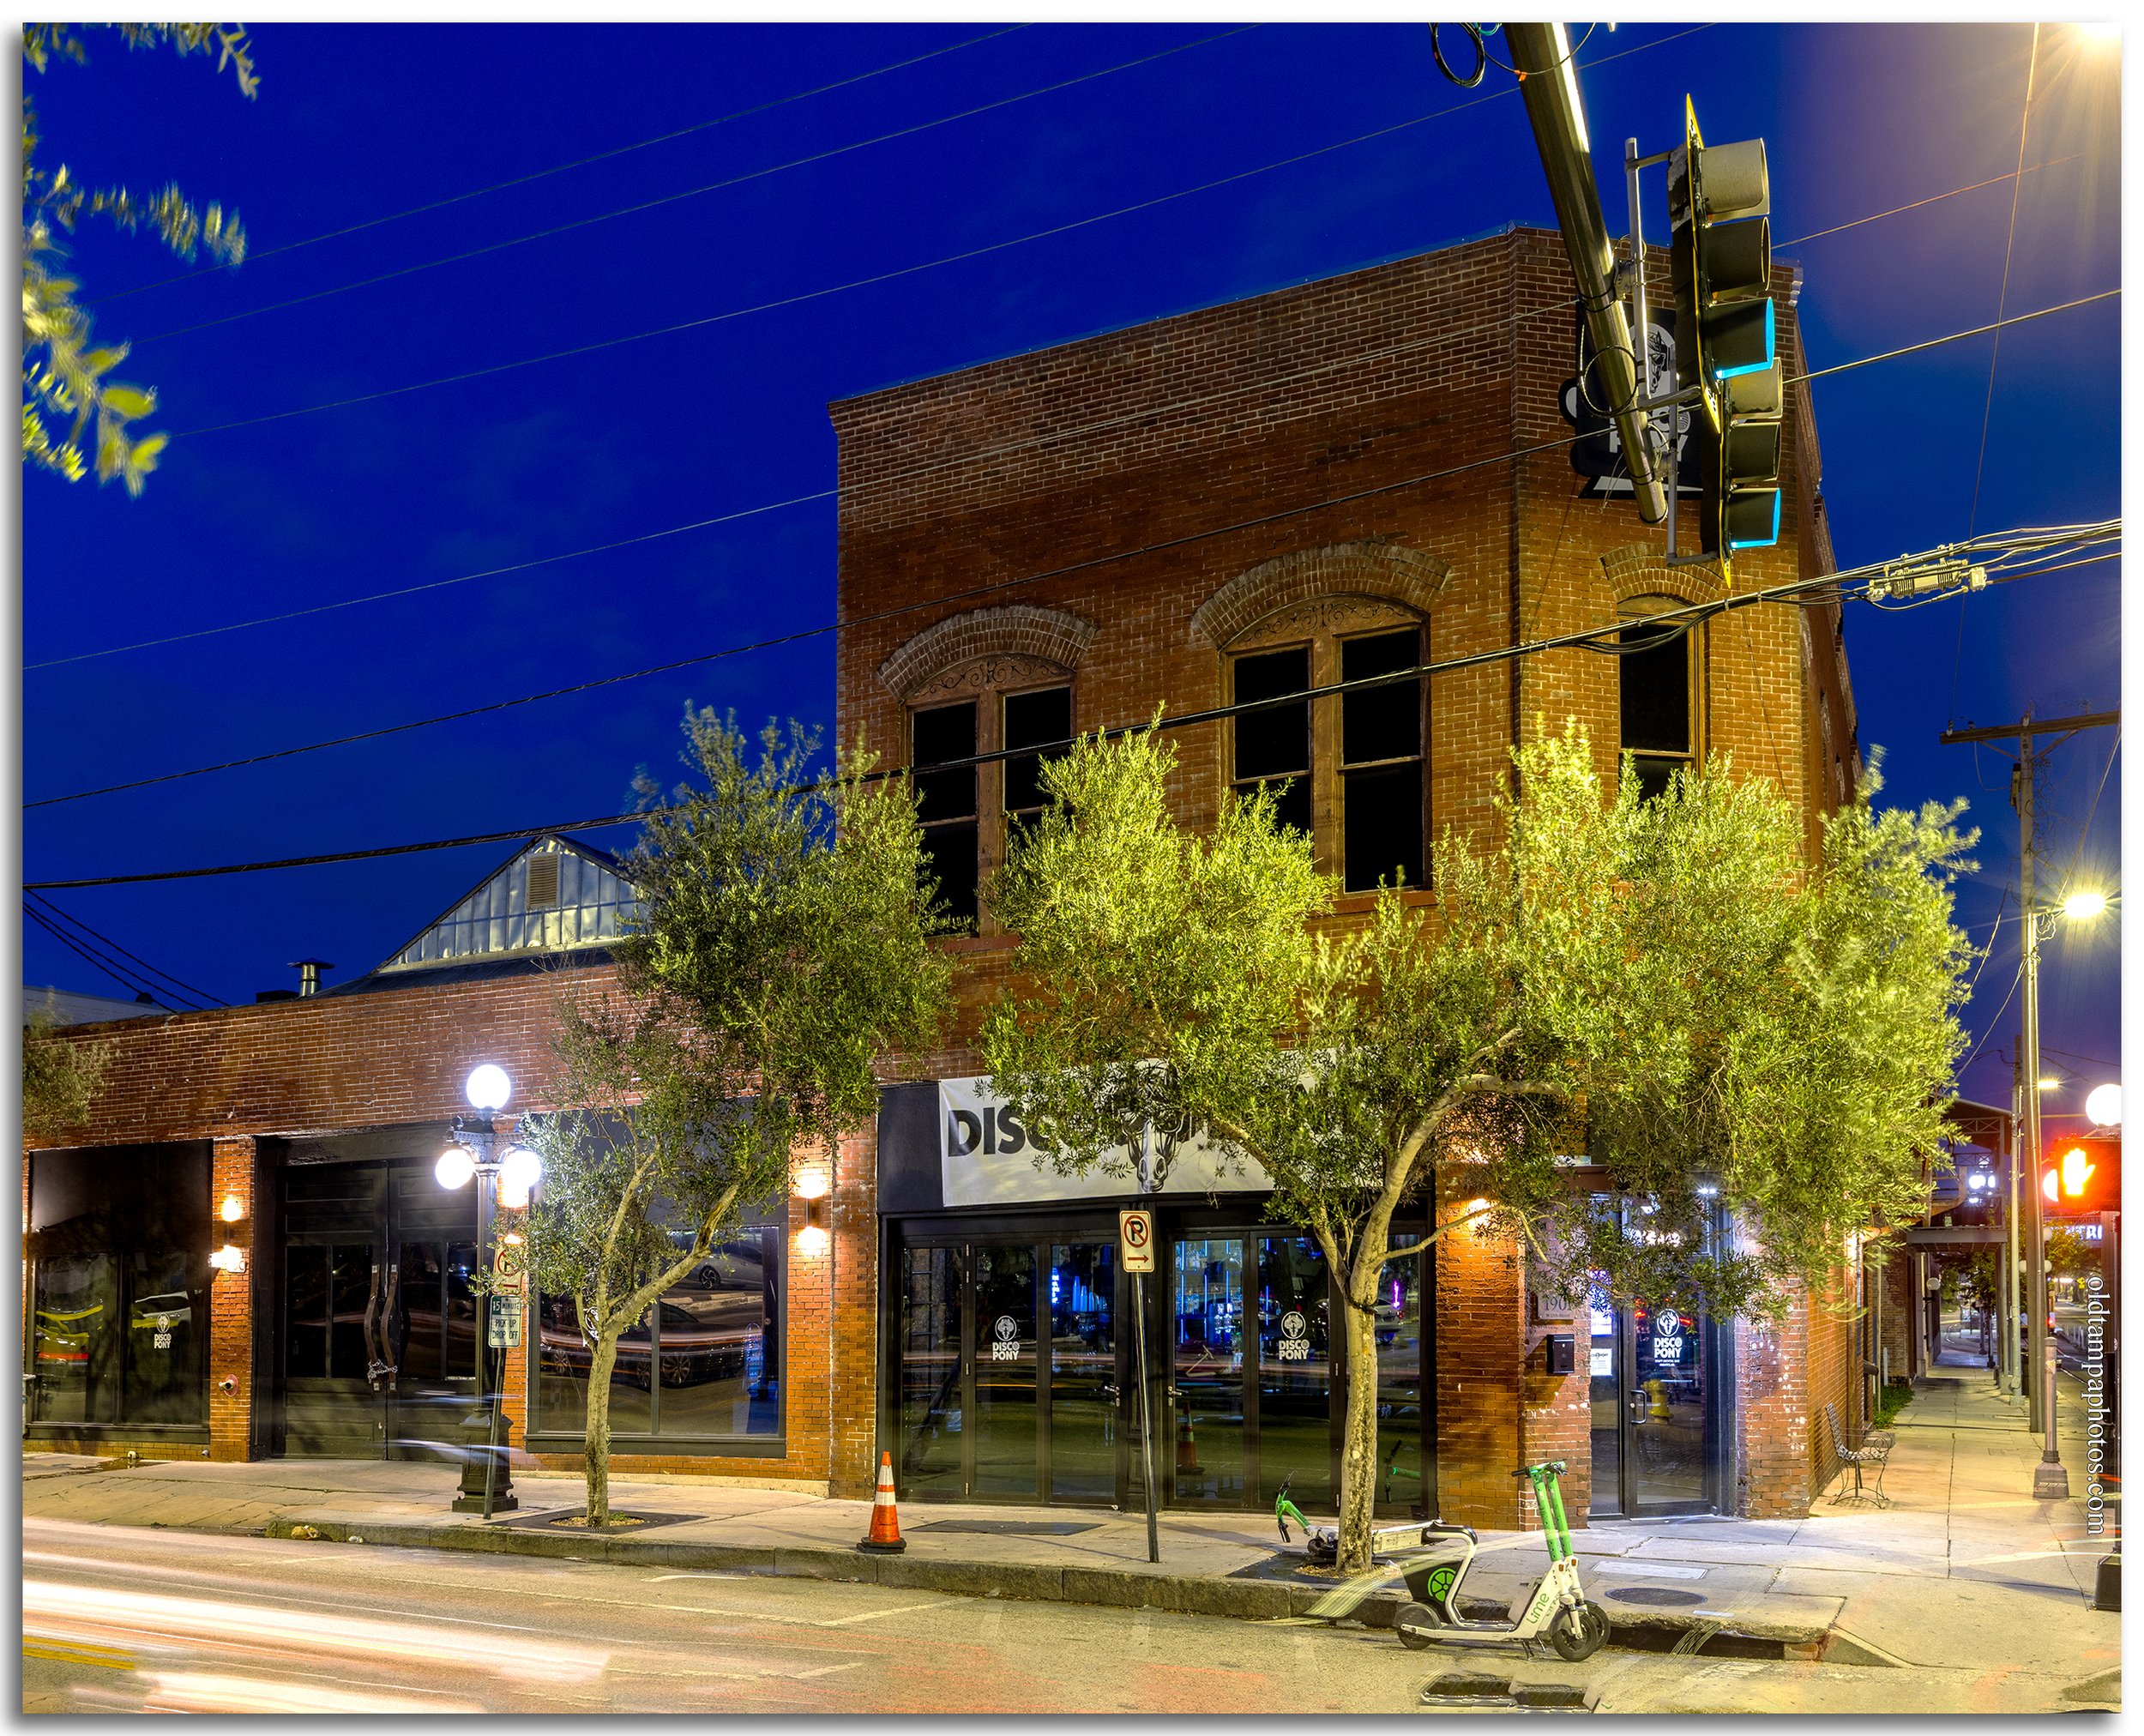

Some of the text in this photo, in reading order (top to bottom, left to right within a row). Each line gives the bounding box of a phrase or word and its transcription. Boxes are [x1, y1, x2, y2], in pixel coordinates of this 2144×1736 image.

[492, 1300, 501, 1311] 15
[495, 1318, 517, 1328] PICK UP
[154, 1333, 172, 1341] DISCO
[492, 1330, 518, 1340] DROP OFF
[154, 1341, 172, 1349] PONY
[992, 1341, 1021, 1352] DISCO
[1278, 1339, 1310, 1350] DISCO
[1653, 1337, 1683, 1348] DISCO
[992, 1350, 1020, 1361] PONY
[1279, 1349, 1310, 1360] PONY
[1654, 1347, 1682, 1359] PONY
